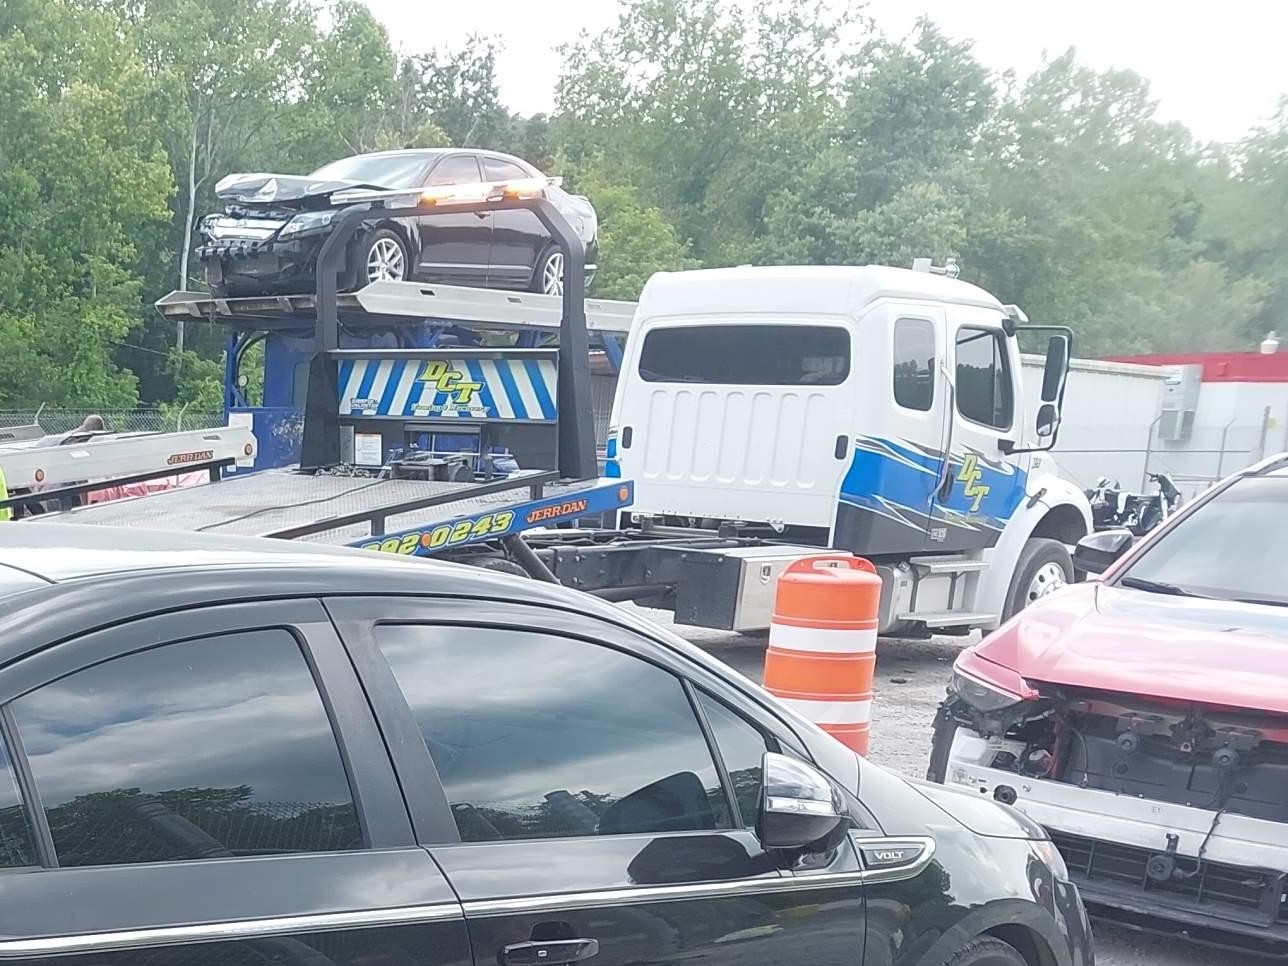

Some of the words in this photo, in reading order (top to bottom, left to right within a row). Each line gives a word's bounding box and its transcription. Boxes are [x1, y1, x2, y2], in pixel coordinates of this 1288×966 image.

[417, 359, 484, 404] DCT
[956, 453, 991, 512] DCT
[874, 850, 905, 860] VOLT
